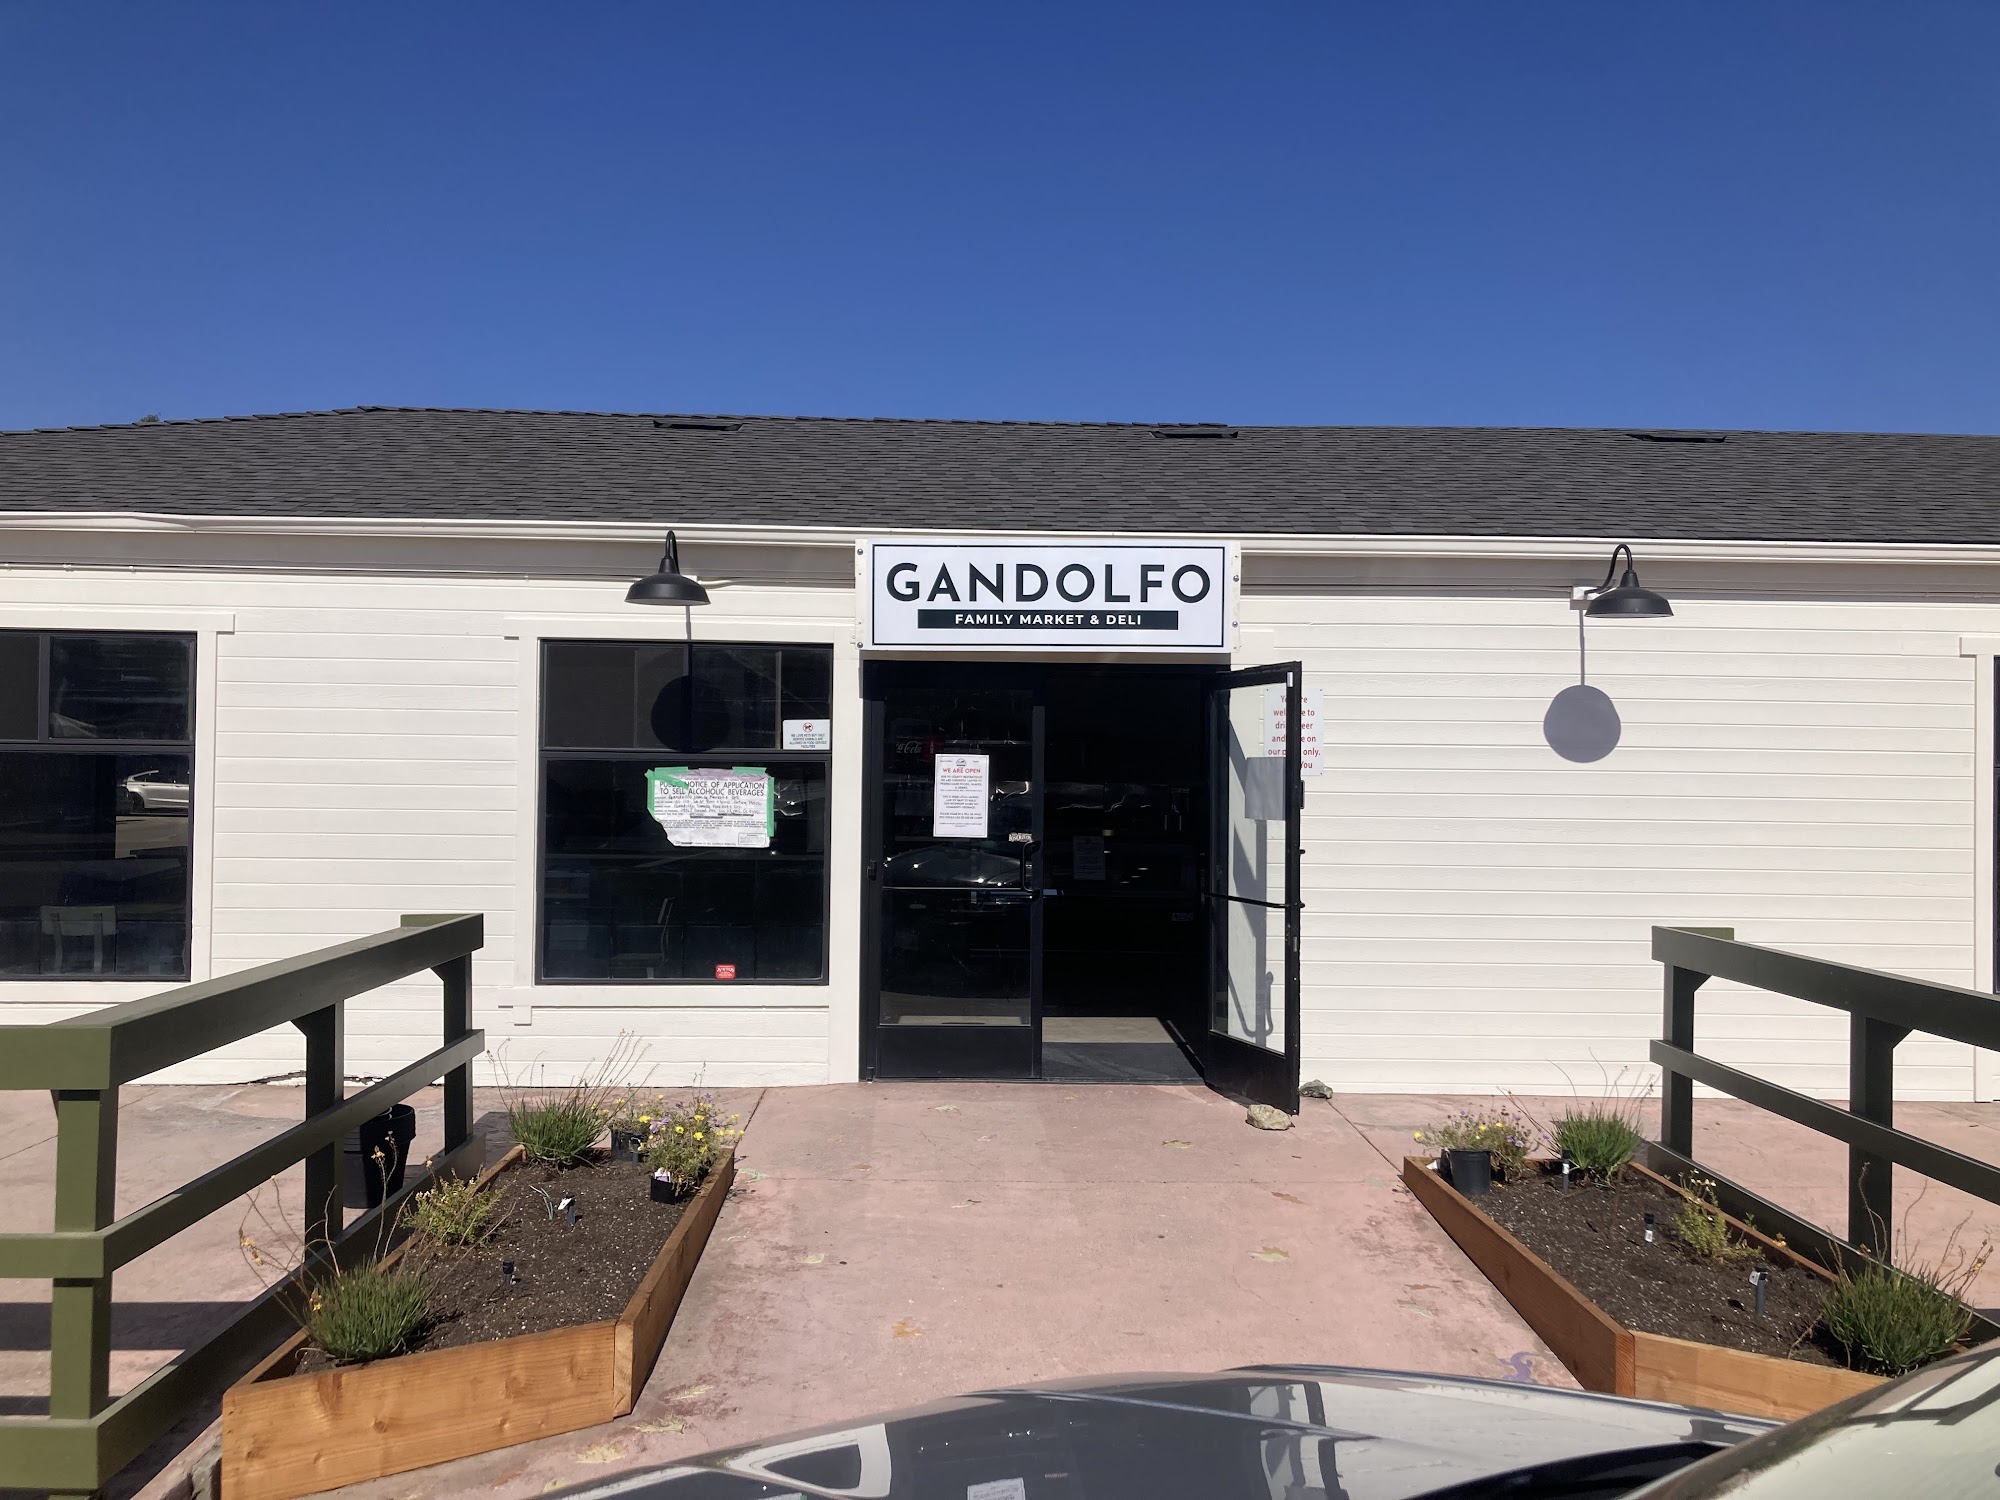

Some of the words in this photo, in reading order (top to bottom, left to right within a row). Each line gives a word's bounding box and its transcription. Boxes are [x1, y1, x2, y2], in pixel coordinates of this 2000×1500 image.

[886, 561, 1212, 604] GANDOLFO
[954, 613, 1014, 626] FAMILY
[1019, 613, 1085, 626] MARKET
[1089, 613, 1100, 626] &
[1105, 613, 1142, 626] DELI
[1271, 734, 1286, 742] and
[724, 781, 765, 790] APPLICATION
[660, 787, 669, 795] TO
[688, 788, 725, 796] ALCOHOLIC
[727, 788, 764, 796] BEVERAGES
